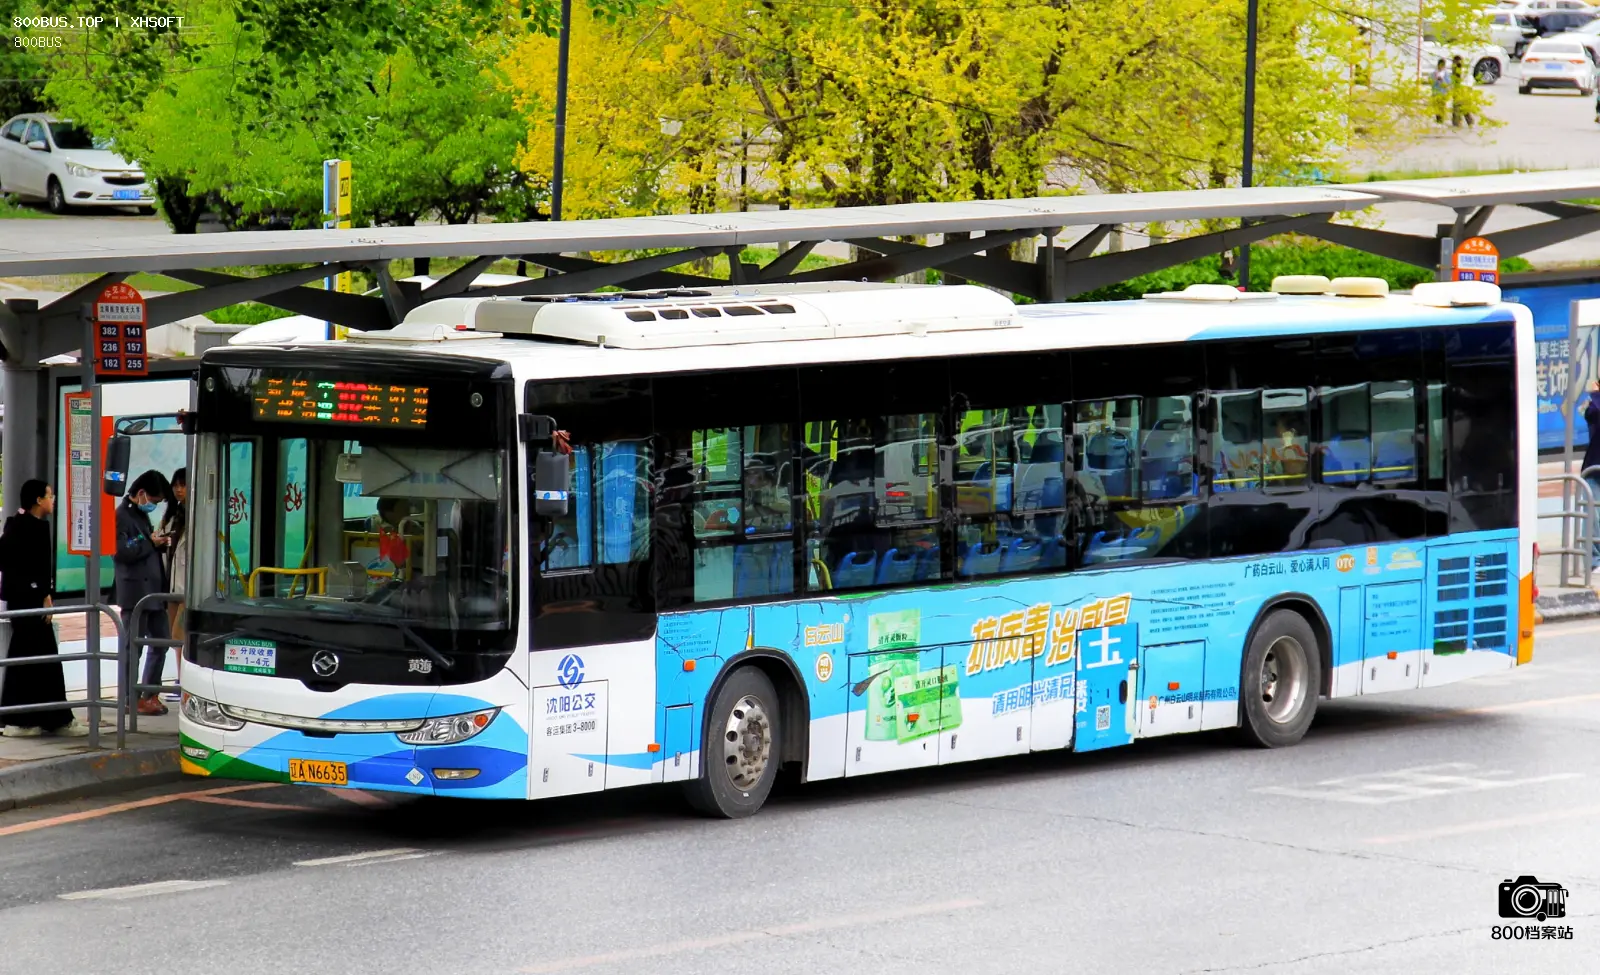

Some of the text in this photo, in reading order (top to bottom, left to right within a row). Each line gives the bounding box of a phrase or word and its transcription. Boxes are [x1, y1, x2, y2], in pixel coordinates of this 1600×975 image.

[102, 326, 117, 336] 382
[126, 327, 141, 336] 141
[102, 343, 118, 352] 236
[126, 342, 141, 352] 157
[104, 358, 118, 368] 182
[127, 359, 142, 369] 255
[1336, 557, 1355, 570] OTC
[804, 623, 845, 648] 白云山
[965, 602, 1051, 676] 抗病毒
[240, 647, 274, 657] 分段收费
[408, 658, 433, 674] 黄海
[992, 671, 1075, 718] 请用明兴清开
[546, 692, 596, 714] 沈阳公交
